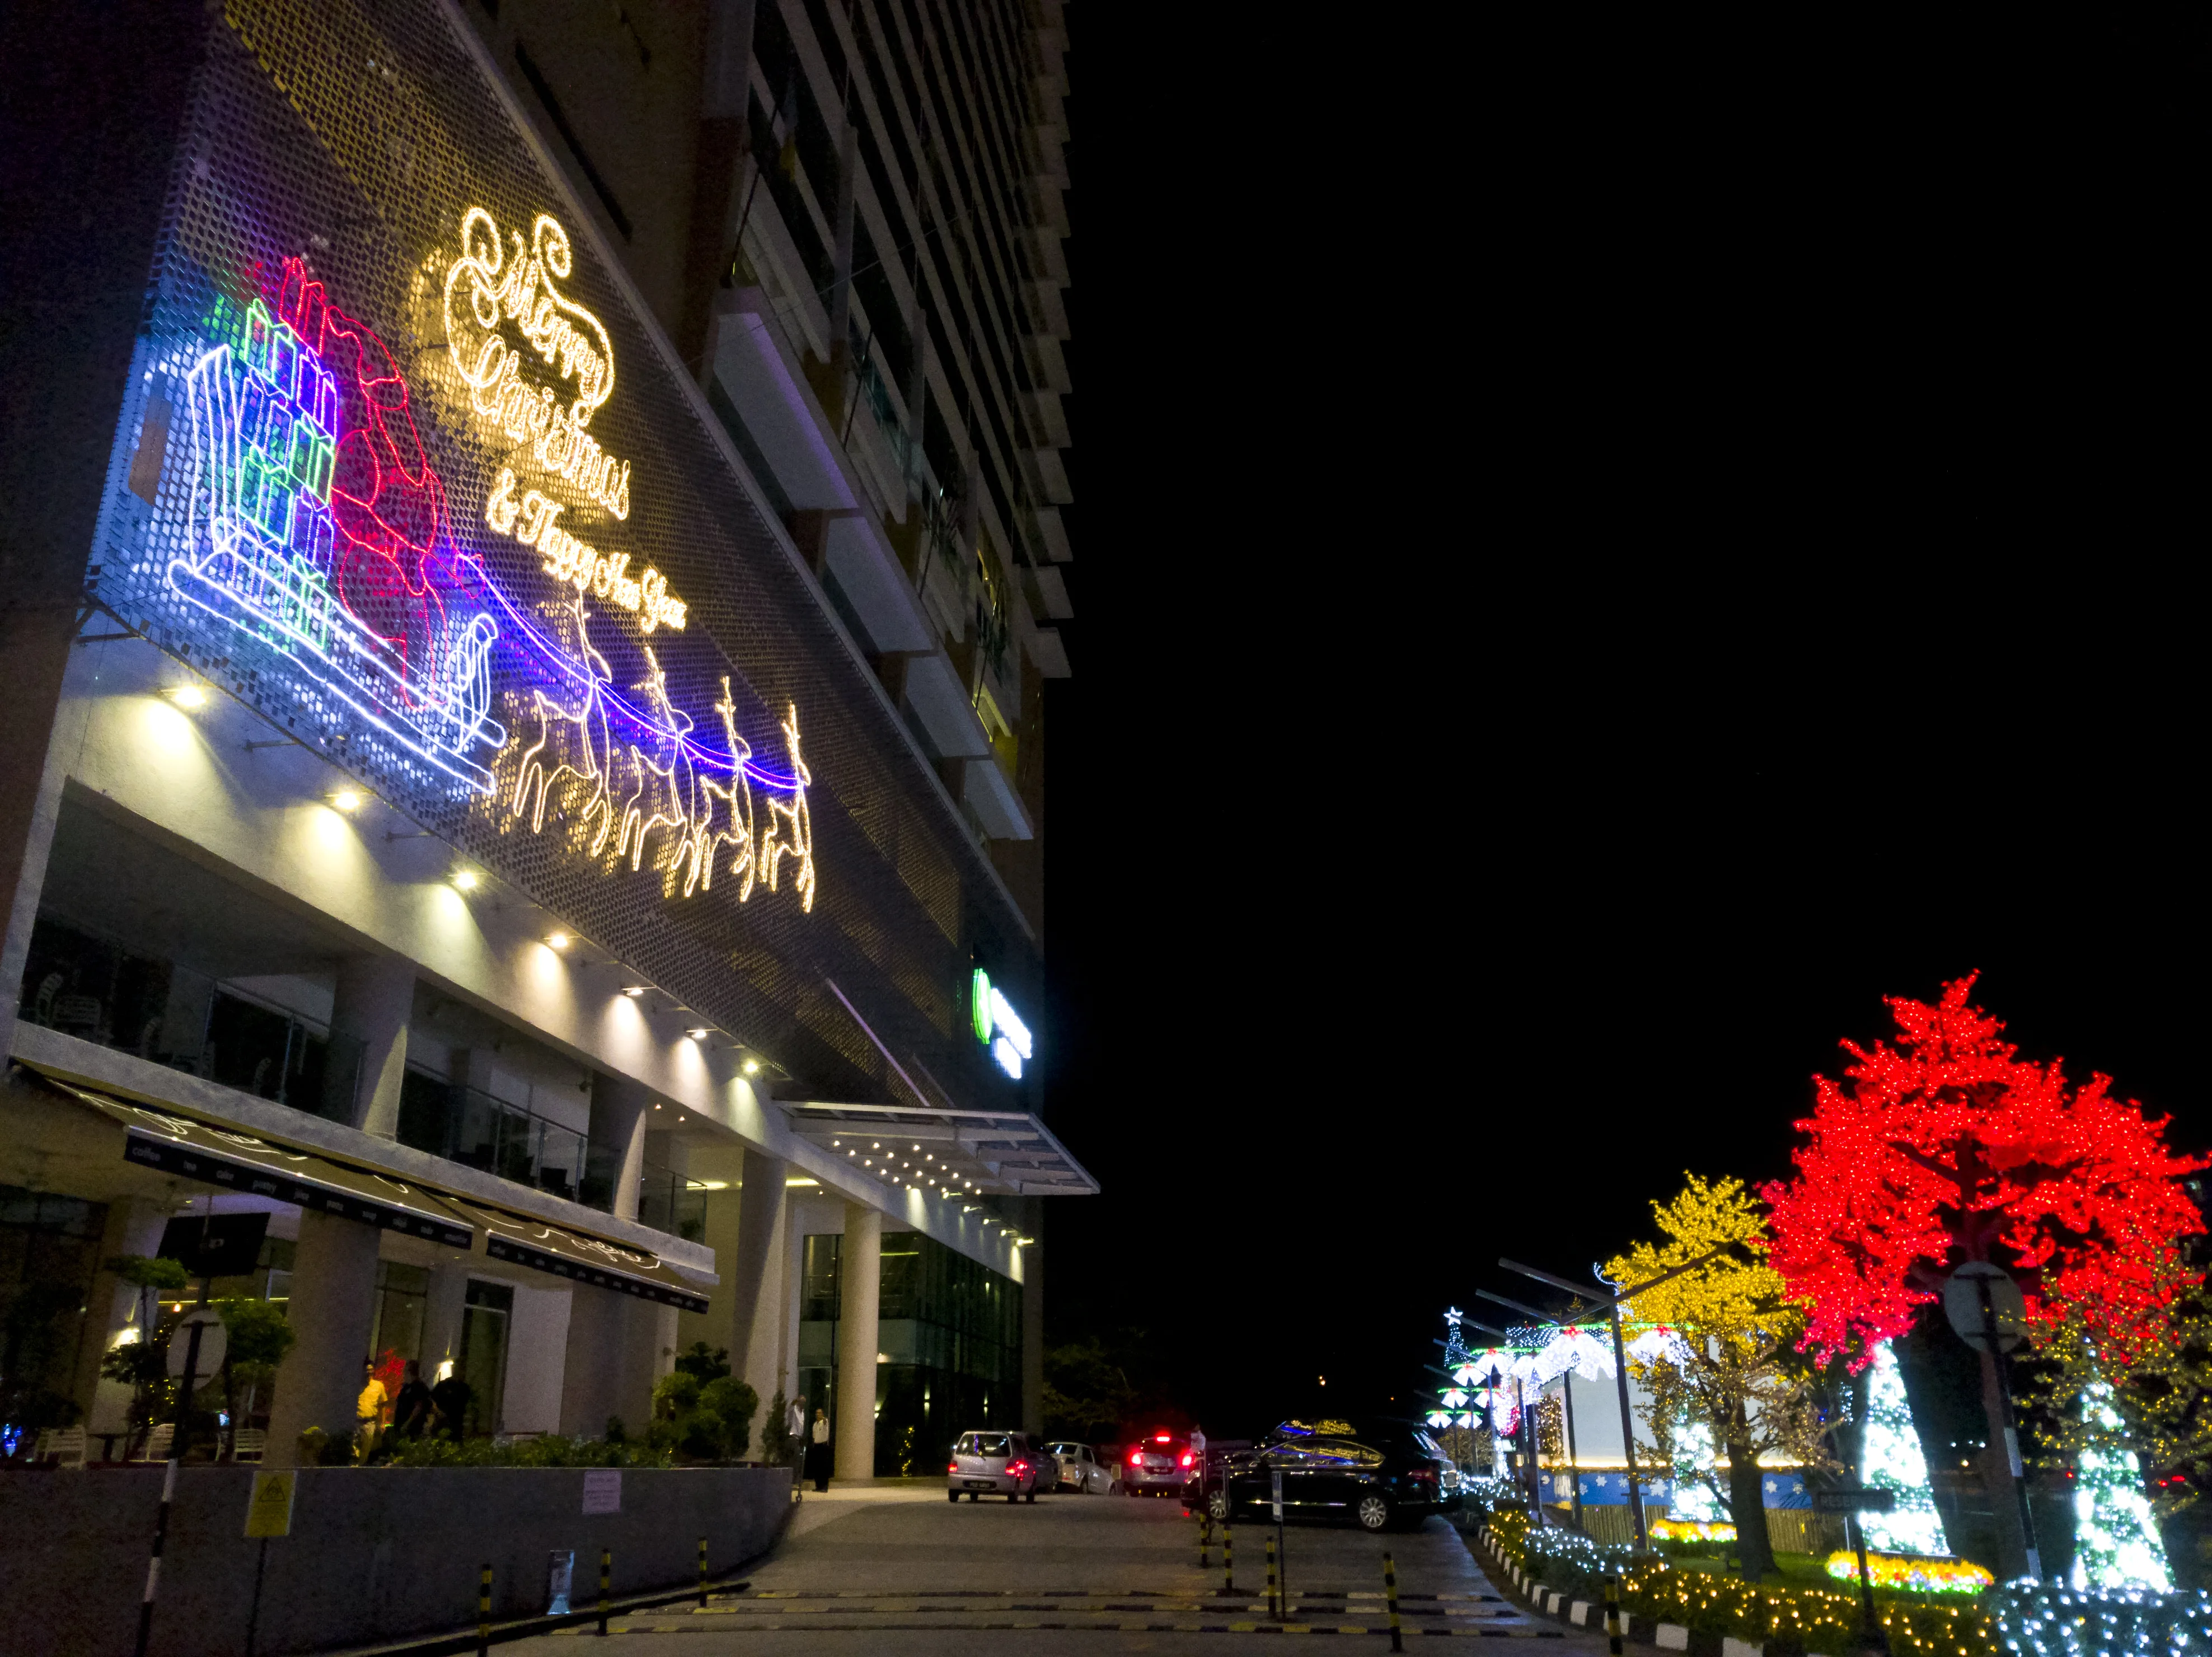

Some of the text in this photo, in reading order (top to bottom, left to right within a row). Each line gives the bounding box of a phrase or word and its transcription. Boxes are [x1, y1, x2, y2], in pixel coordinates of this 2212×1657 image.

[465, 207, 616, 404] Merry
[472, 334, 631, 521] Christmas
[485, 468, 520, 535] &
[516, 489, 598, 590] Happy
[593, 551, 641, 613] New
